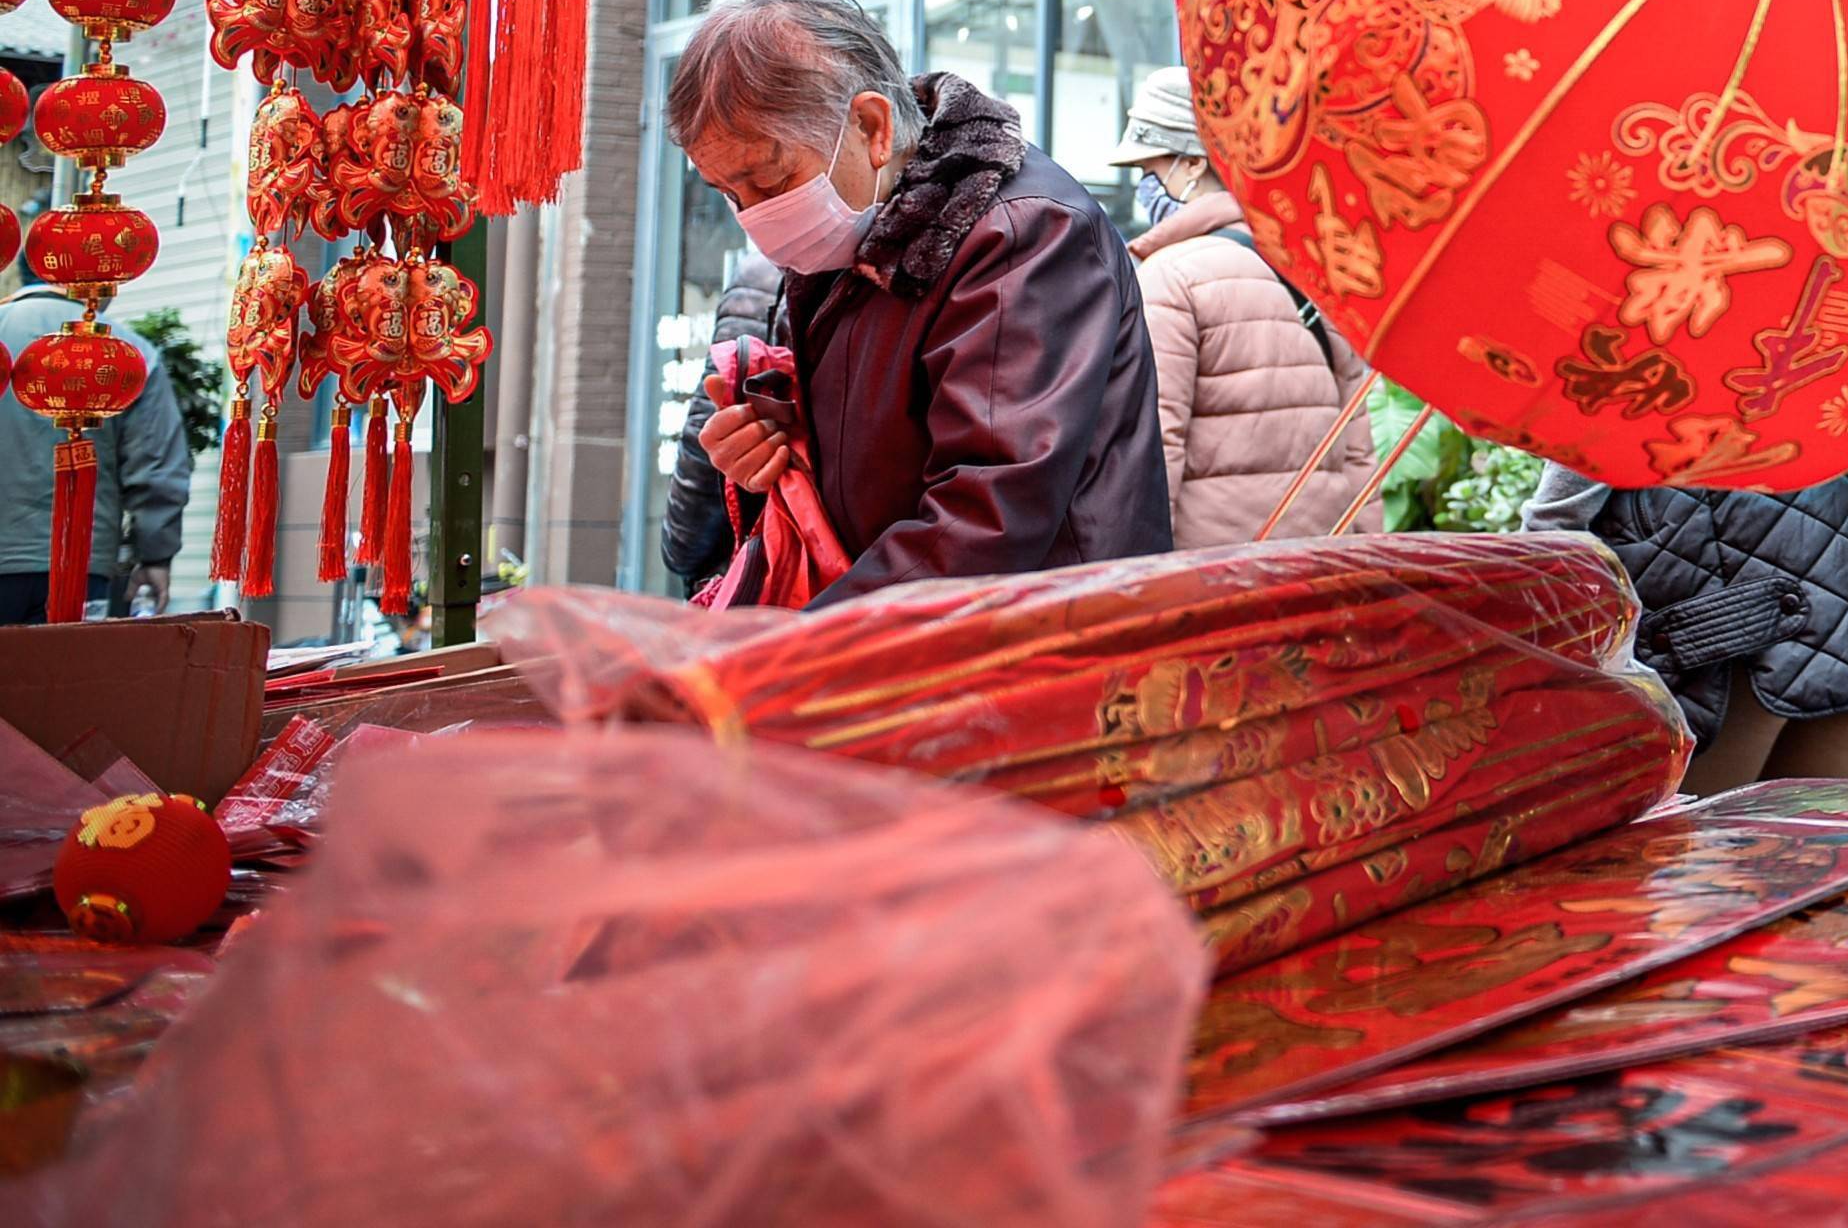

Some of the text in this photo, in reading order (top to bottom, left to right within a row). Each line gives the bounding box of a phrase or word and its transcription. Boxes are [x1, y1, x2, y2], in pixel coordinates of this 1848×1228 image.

[382, 143, 408, 170] 福
[421, 148, 448, 175] 福
[377, 311, 404, 338] 福
[415, 310, 442, 337] 福
